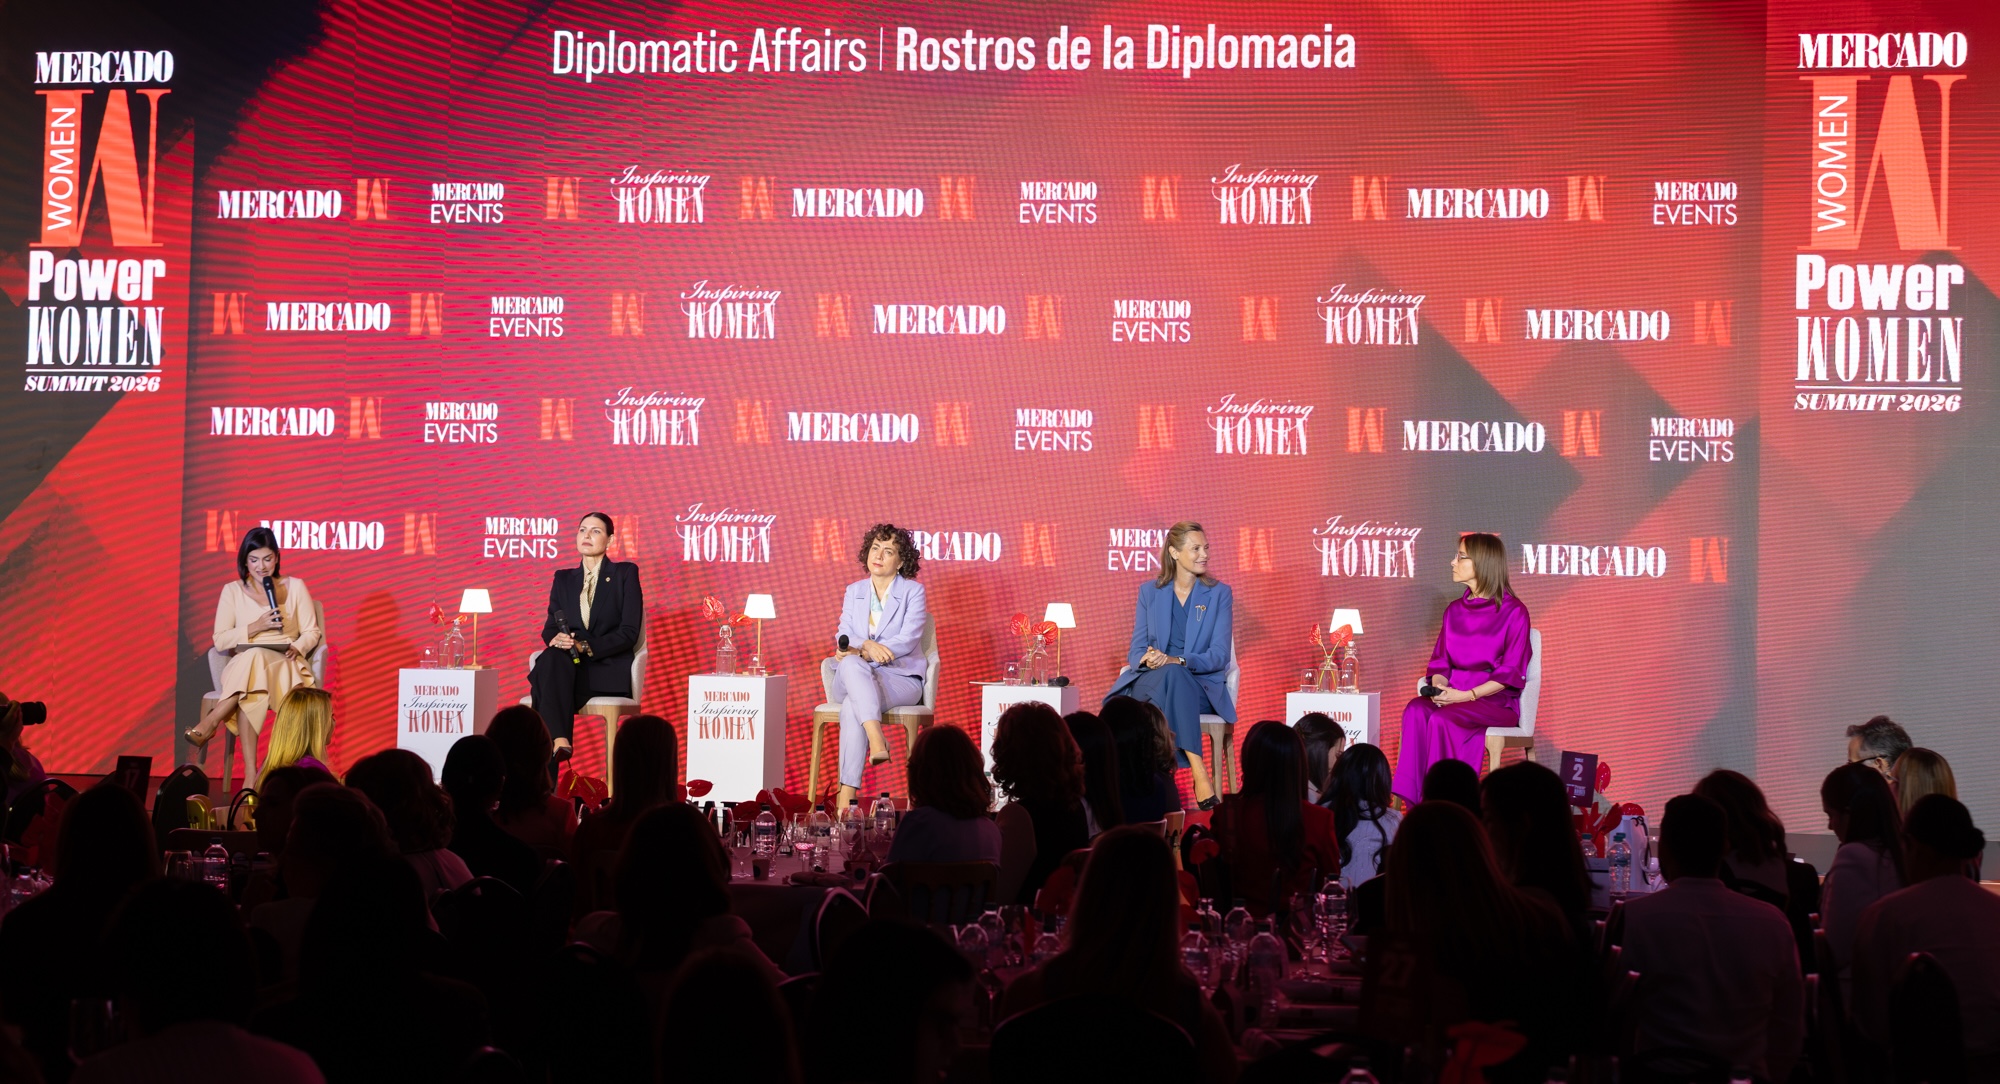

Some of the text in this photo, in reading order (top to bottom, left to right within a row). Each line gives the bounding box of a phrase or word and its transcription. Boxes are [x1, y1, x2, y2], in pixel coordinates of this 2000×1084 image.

[553, 23, 1356, 83] Diplomatic Affairs Rostros de la Diplomacia
[1797, 31, 1968, 69] MERCADO
[34, 50, 174, 84] MERCADO
[47, 107, 76, 231] WOMEN
[1817, 95, 1848, 232] WOMEN
[432, 183, 505, 201] MERCADO
[610, 164, 711, 201] Inspiring
[1020, 181, 1098, 201] MERCADO
[1211, 163, 1319, 202] Inspiring
[1653, 181, 1738, 201] MERCADO
[217, 190, 342, 219] MERCADO
[430, 203, 504, 224] EVENTS
[618, 187, 705, 224] WOMEN
[791, 187, 924, 218] MERCADO
[1019, 203, 1097, 224] EVENTS
[1220, 186, 1313, 225] WOMEN
[1406, 188, 1549, 219] MERCADO
[1653, 203, 1738, 226] EVENTS
[28, 250, 166, 302] Power
[1795, 254, 1965, 311] Power
[491, 296, 564, 315] MERCADO
[680, 279, 782, 317] Inspiring
[1114, 299, 1192, 319] MERCADO
[1316, 283, 1426, 322] Inspiring
[265, 302, 391, 332] MERCADO
[489, 316, 564, 338] EVENTS
[688, 301, 776, 340] WOMEN
[873, 304, 1006, 335] MERCADO
[1112, 321, 1191, 343] EVENTS
[1325, 306, 1420, 346] WOMEN
[1525, 309, 1670, 341] MERCADO
[26, 306, 165, 366] WOMEN
[1794, 316, 1963, 383] WOMEN
[24, 375, 161, 393] SUMMIT 2026
[425, 402, 499, 421] MERCADO
[604, 386, 706, 424] Inspiring
[1015, 408, 1093, 428] MERCADO
[1206, 393, 1314, 433] Inspiring
[1794, 393, 1962, 412] SUMMIT 2026
[210, 407, 335, 437] MERCADO
[424, 423, 498, 444] EVENTS
[613, 408, 700, 446] WOMEN
[787, 411, 919, 443] MERCADO
[1215, 416, 1308, 456] WOMEN
[1402, 420, 1546, 453] MERCADO
[1650, 417, 1734, 438] MERCADO
[1014, 430, 1093, 452] EVENTS
[1649, 440, 1734, 463] EVENTS
[485, 517, 559, 536] MERCADO
[675, 502, 777, 541] Inspiring
[1312, 515, 1422, 555] Inspiring
[484, 537, 558, 559] EVENTS
[683, 524, 771, 563] WOMEN
[911, 530, 1002, 562] RCADO
[1108, 528, 1170, 548] MERCA
[1107, 549, 1162, 572] EVEN
[1321, 537, 1415, 578] WOMEN
[1520, 543, 1667, 578] MERCADO
[413, 685, 460, 696] MERCADO
[703, 691, 751, 702] MERCADO
[403, 696, 468, 720] Inspiring
[408, 709, 465, 734] WOMEN
[693, 702, 759, 726] Inspiring
[699, 715, 756, 740] WOMEN
[1572, 763, 1584, 781] 2
